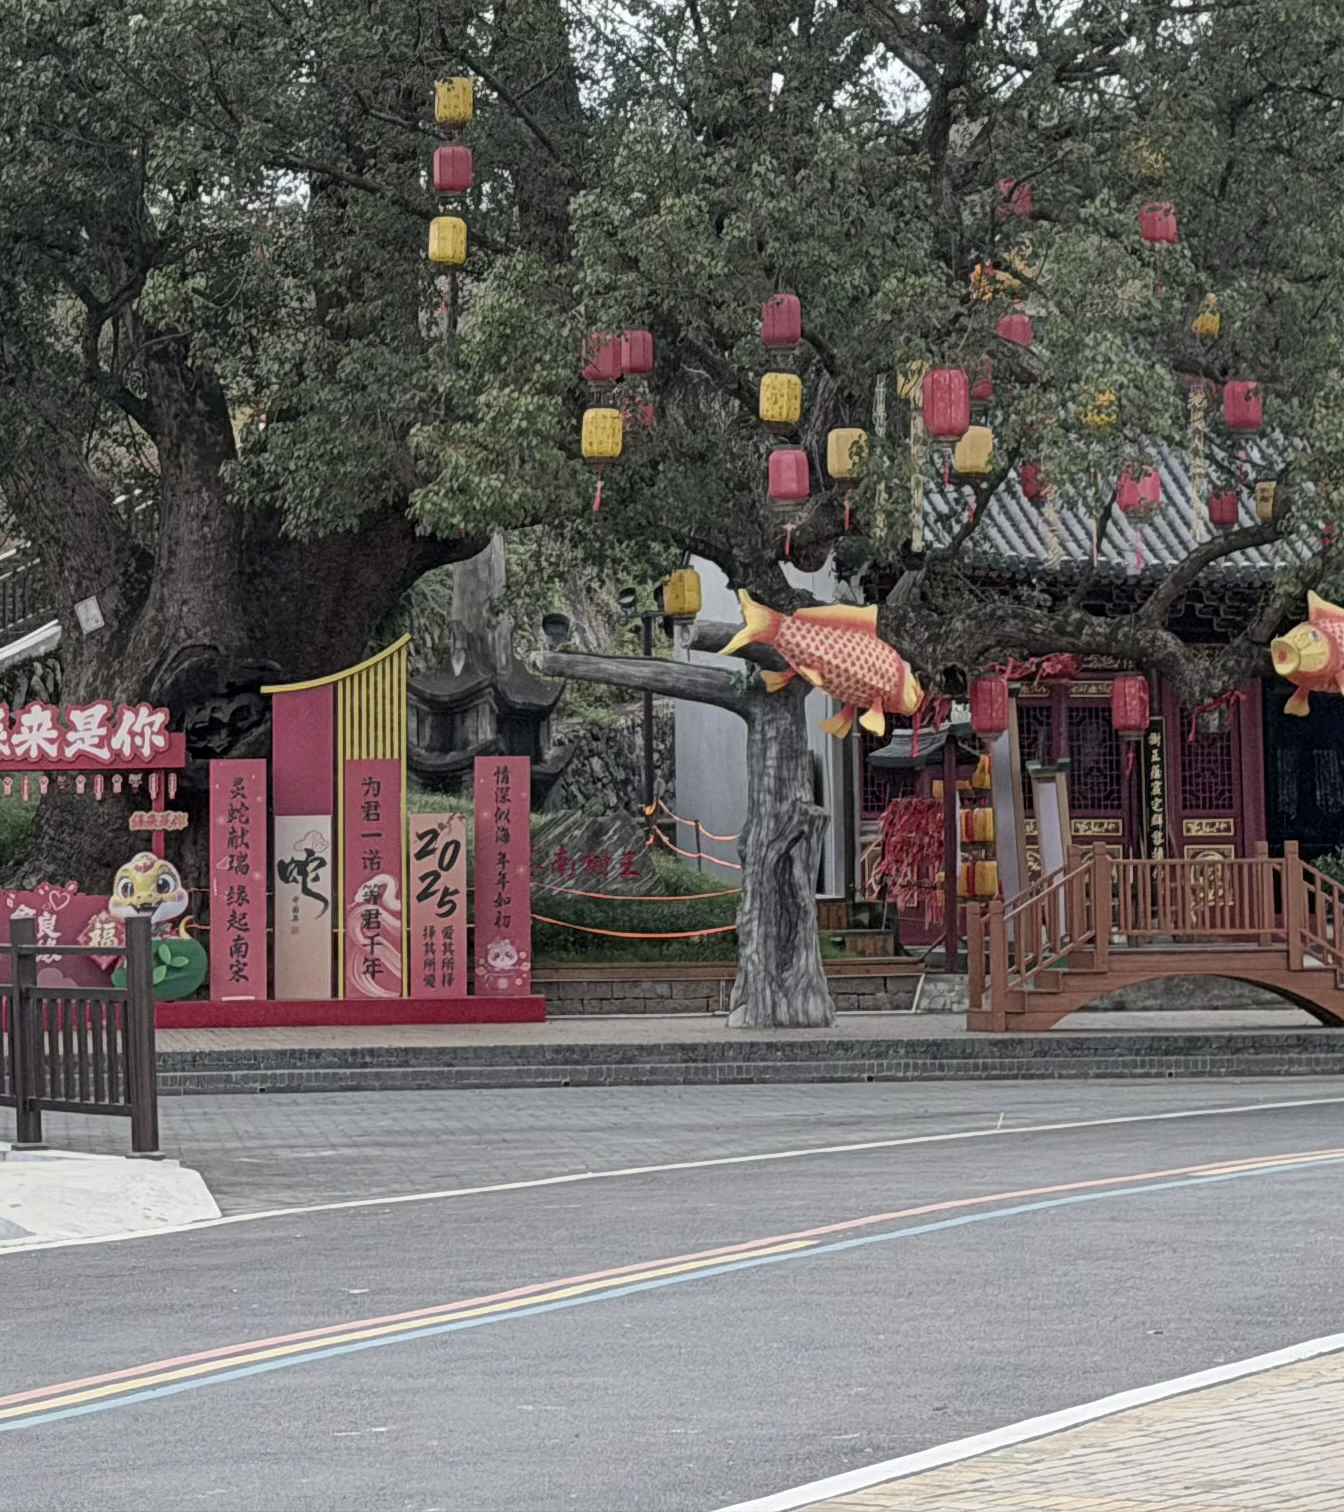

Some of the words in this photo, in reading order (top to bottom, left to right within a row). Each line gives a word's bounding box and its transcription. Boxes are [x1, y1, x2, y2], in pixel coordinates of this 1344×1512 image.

[227, 777, 251, 876] 灵蛇献瑞
[361, 776, 383, 872] 为君一诺
[277, 847, 330, 921] 蛇
[88, 921, 119, 948] 福
[226, 884, 251, 983] 缘起南宋
